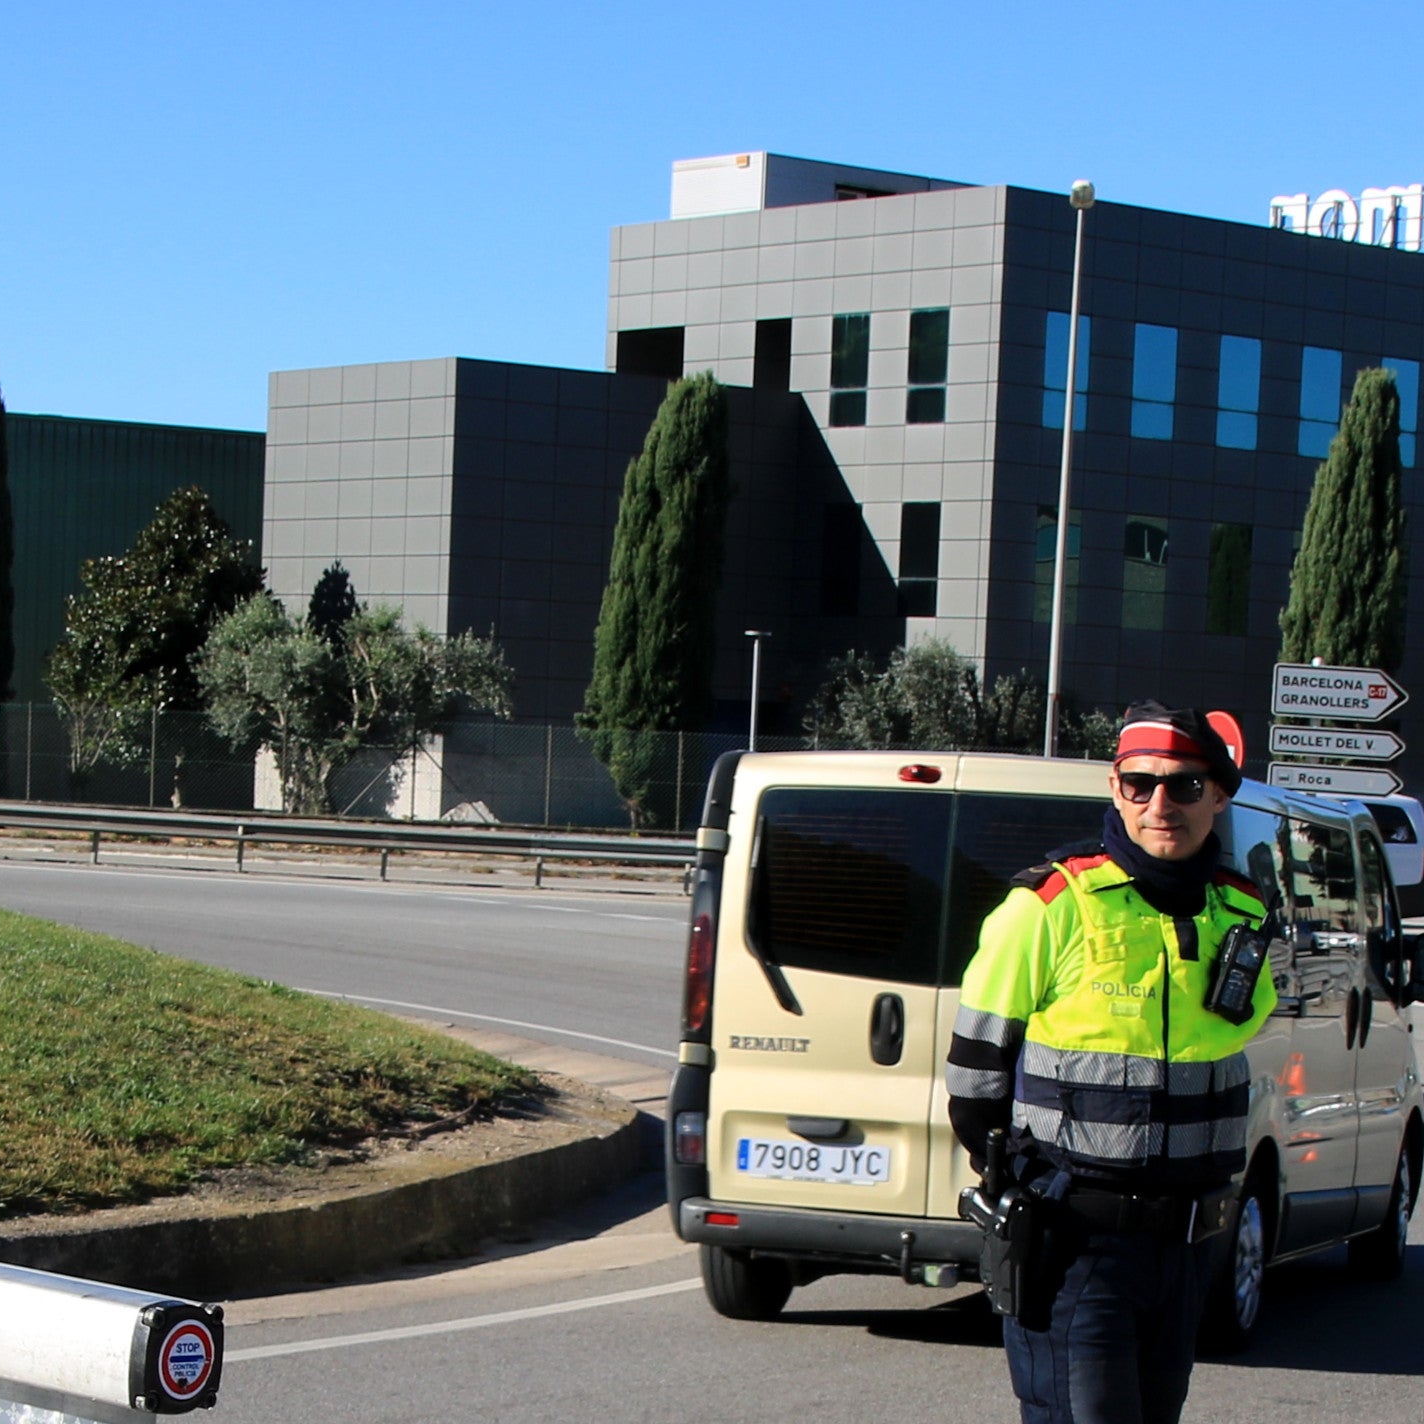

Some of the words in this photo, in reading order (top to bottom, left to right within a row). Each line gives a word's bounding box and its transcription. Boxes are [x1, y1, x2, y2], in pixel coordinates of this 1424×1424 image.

[1282, 676, 1363, 691] BARCELONA
[1368, 687, 1387, 697] C-17
[1281, 694, 1369, 709] GRANOLLERS
[1278, 734, 1332, 747] MOLLET
[1336, 738, 1360, 749] DEL
[1298, 773, 1332, 785] Roca
[1091, 982, 1156, 999] POLICIA
[729, 1035, 811, 1053] RENAULT
[754, 1143, 820, 1172] 7908
[832, 1149, 882, 1176] JYC
[176, 1343, 200, 1353] STOP
[172, 1363, 199, 1371] CONTROL
